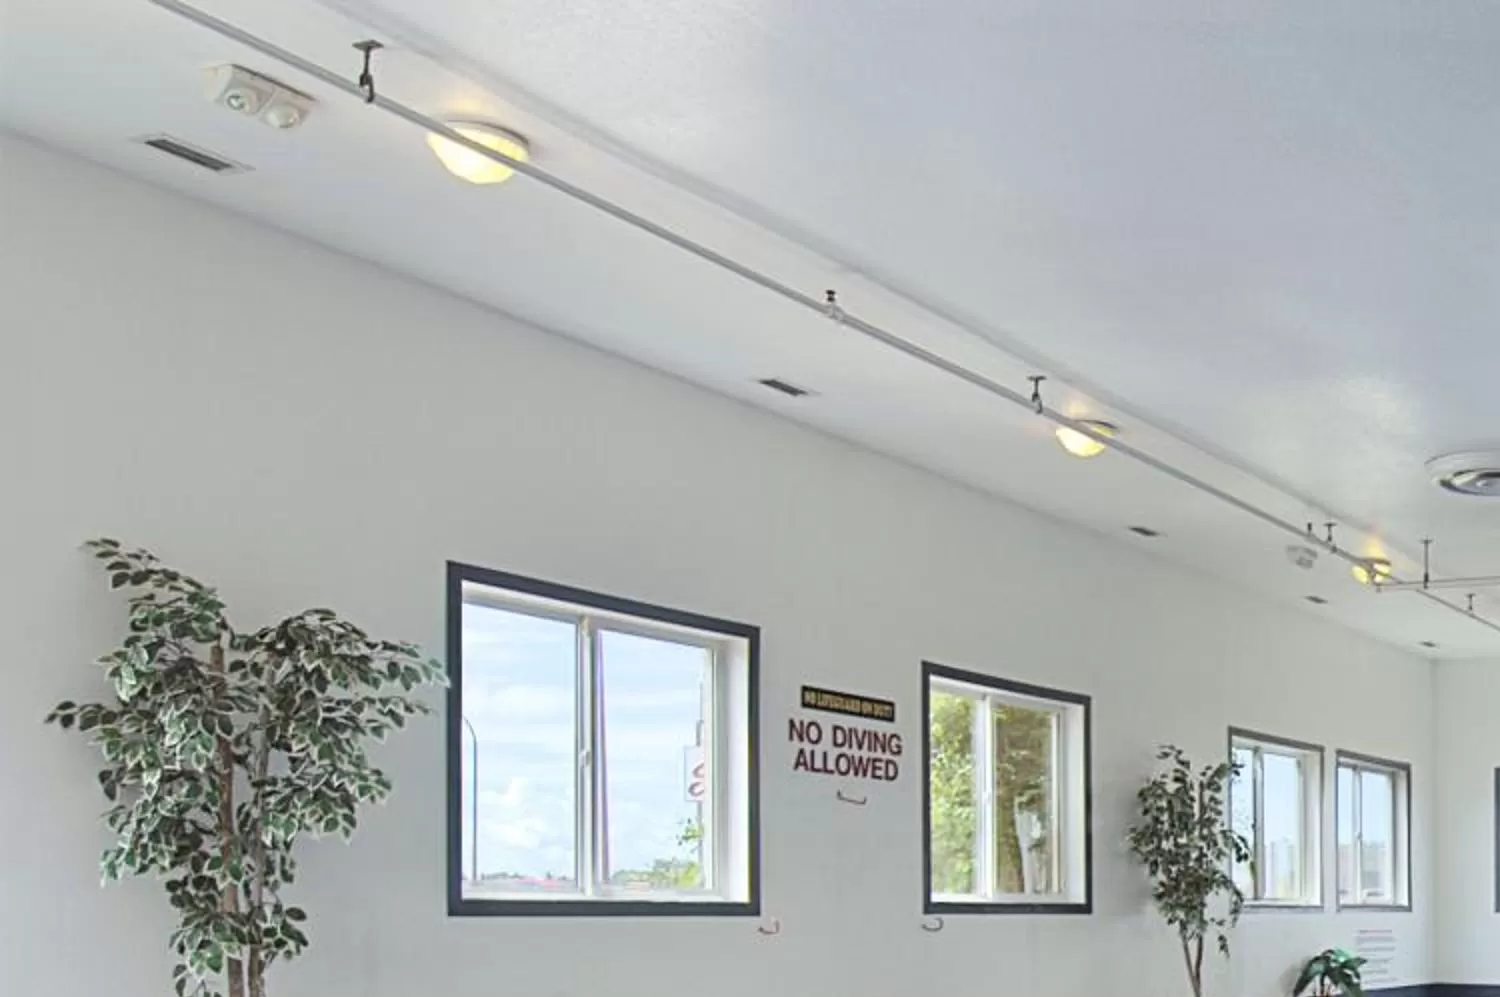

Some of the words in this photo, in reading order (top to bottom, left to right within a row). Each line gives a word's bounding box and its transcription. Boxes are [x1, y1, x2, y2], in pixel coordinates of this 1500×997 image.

[788, 717, 823, 745] NO
[832, 725, 903, 756] DIVING
[793, 748, 899, 781] ALLOWED
